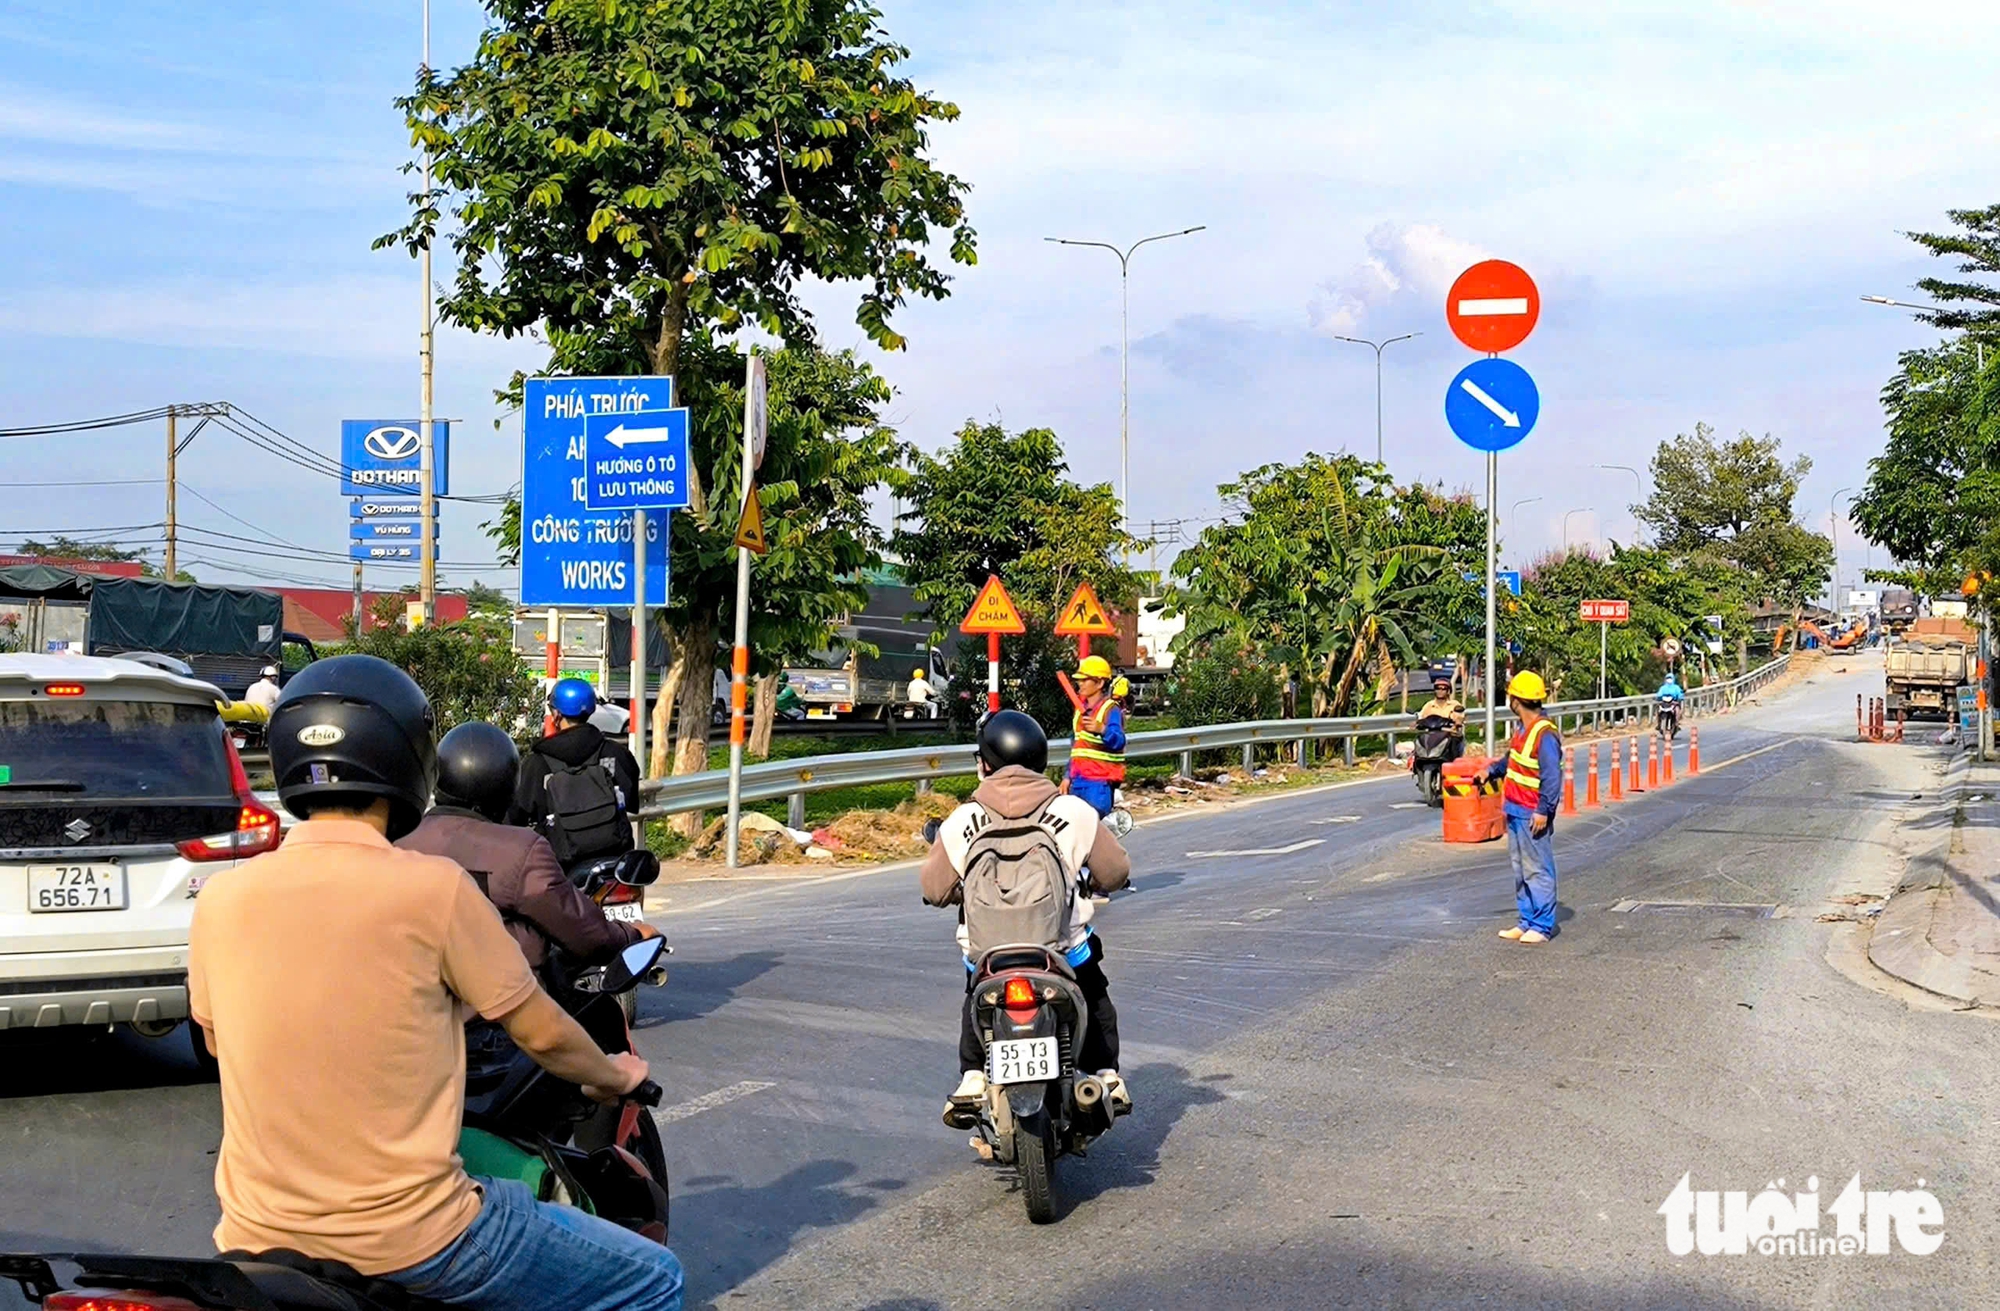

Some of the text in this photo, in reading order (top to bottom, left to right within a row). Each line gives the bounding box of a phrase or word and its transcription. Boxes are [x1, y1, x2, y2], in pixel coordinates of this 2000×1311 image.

[545, 387, 650, 418] PHÍA TRƯỚC
[596, 455, 676, 475] HƯỚNG Ô TÔ
[599, 478, 675, 497] LƯU THÔNG
[531, 511, 657, 543] CÔNG TRƯỜG
[561, 561, 626, 589] WORKS
[304, 729, 336, 741] Asia
[55, 867, 96, 886] 72A
[39, 887, 112, 908] 656.71
[1001, 1060, 1049, 1079] 2169
